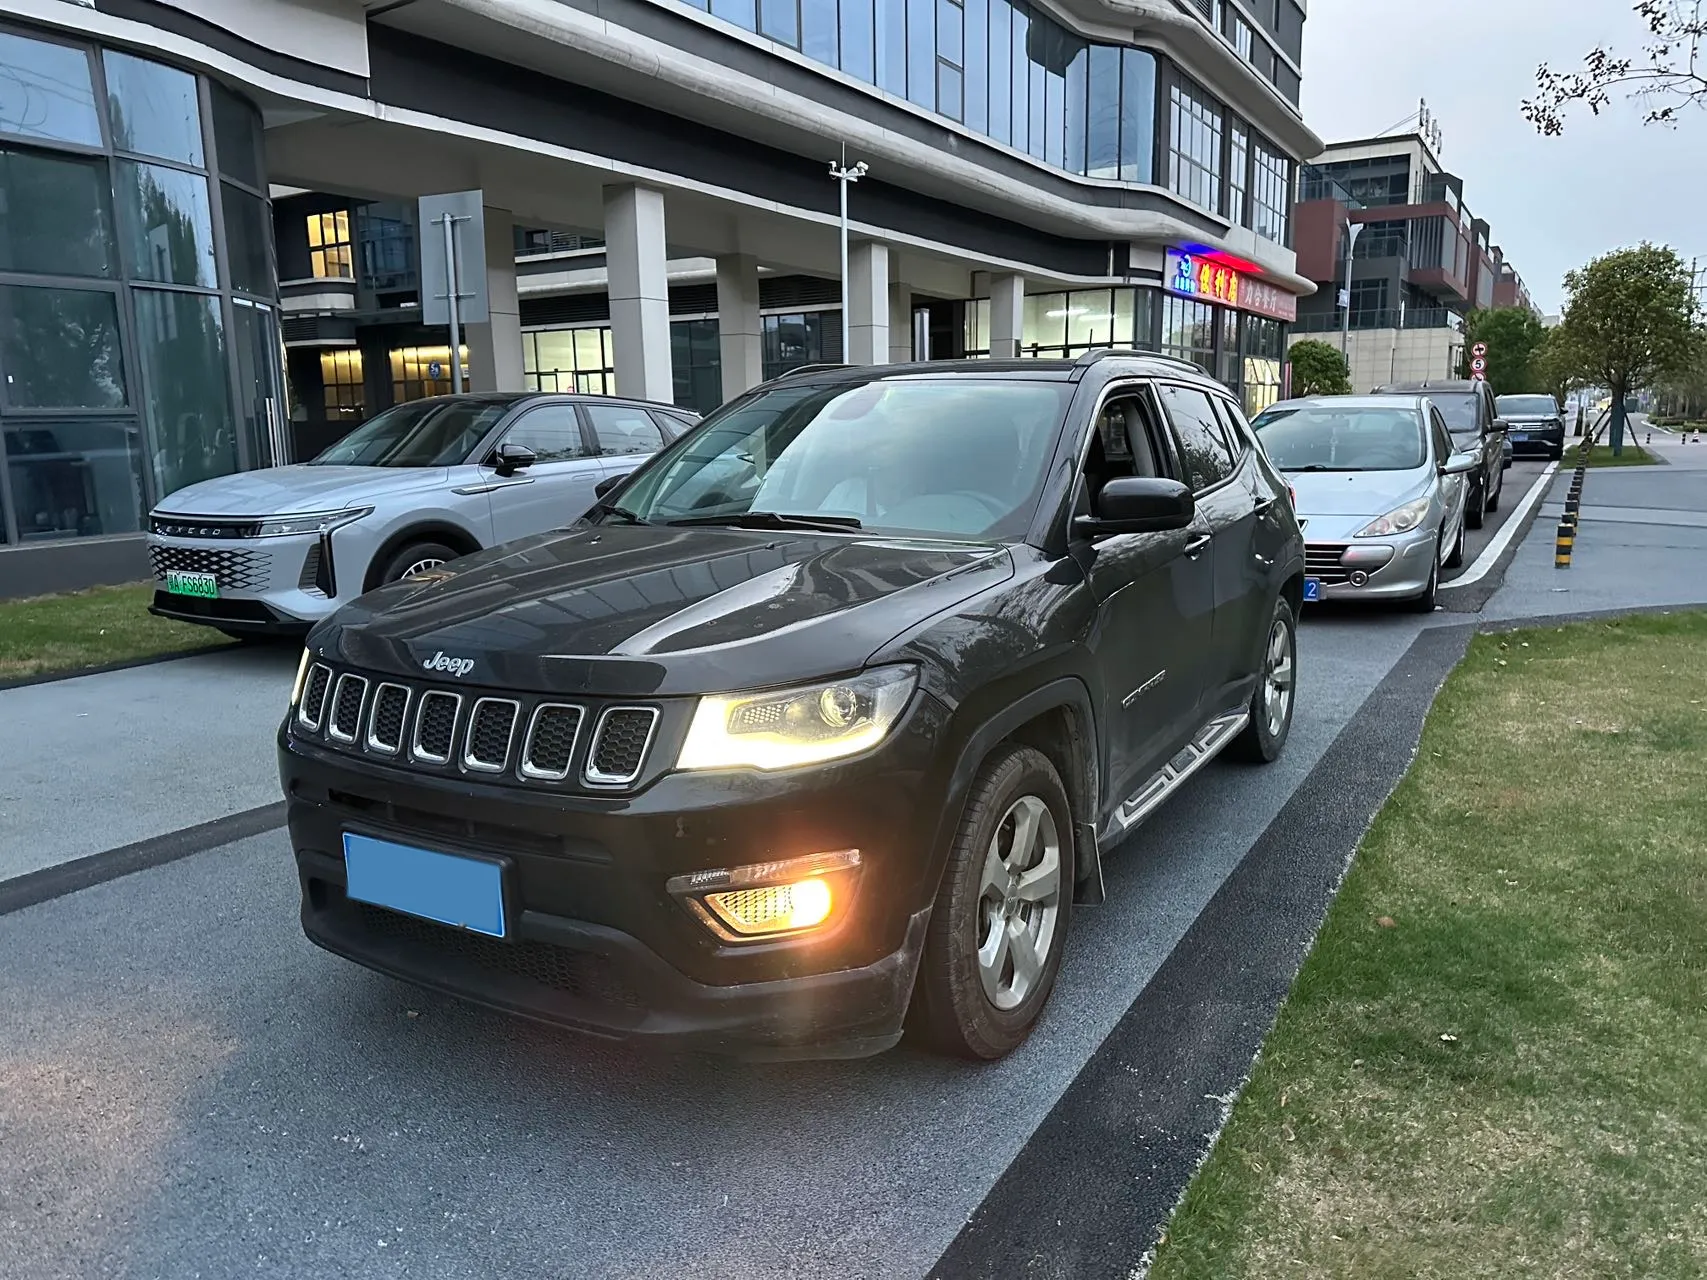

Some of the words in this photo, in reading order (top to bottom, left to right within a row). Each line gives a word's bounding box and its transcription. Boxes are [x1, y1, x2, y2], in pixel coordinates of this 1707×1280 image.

[1475, 360, 1482, 369] 5
[1307, 582, 1316, 597] 2
[423, 651, 475, 677] Jeep
